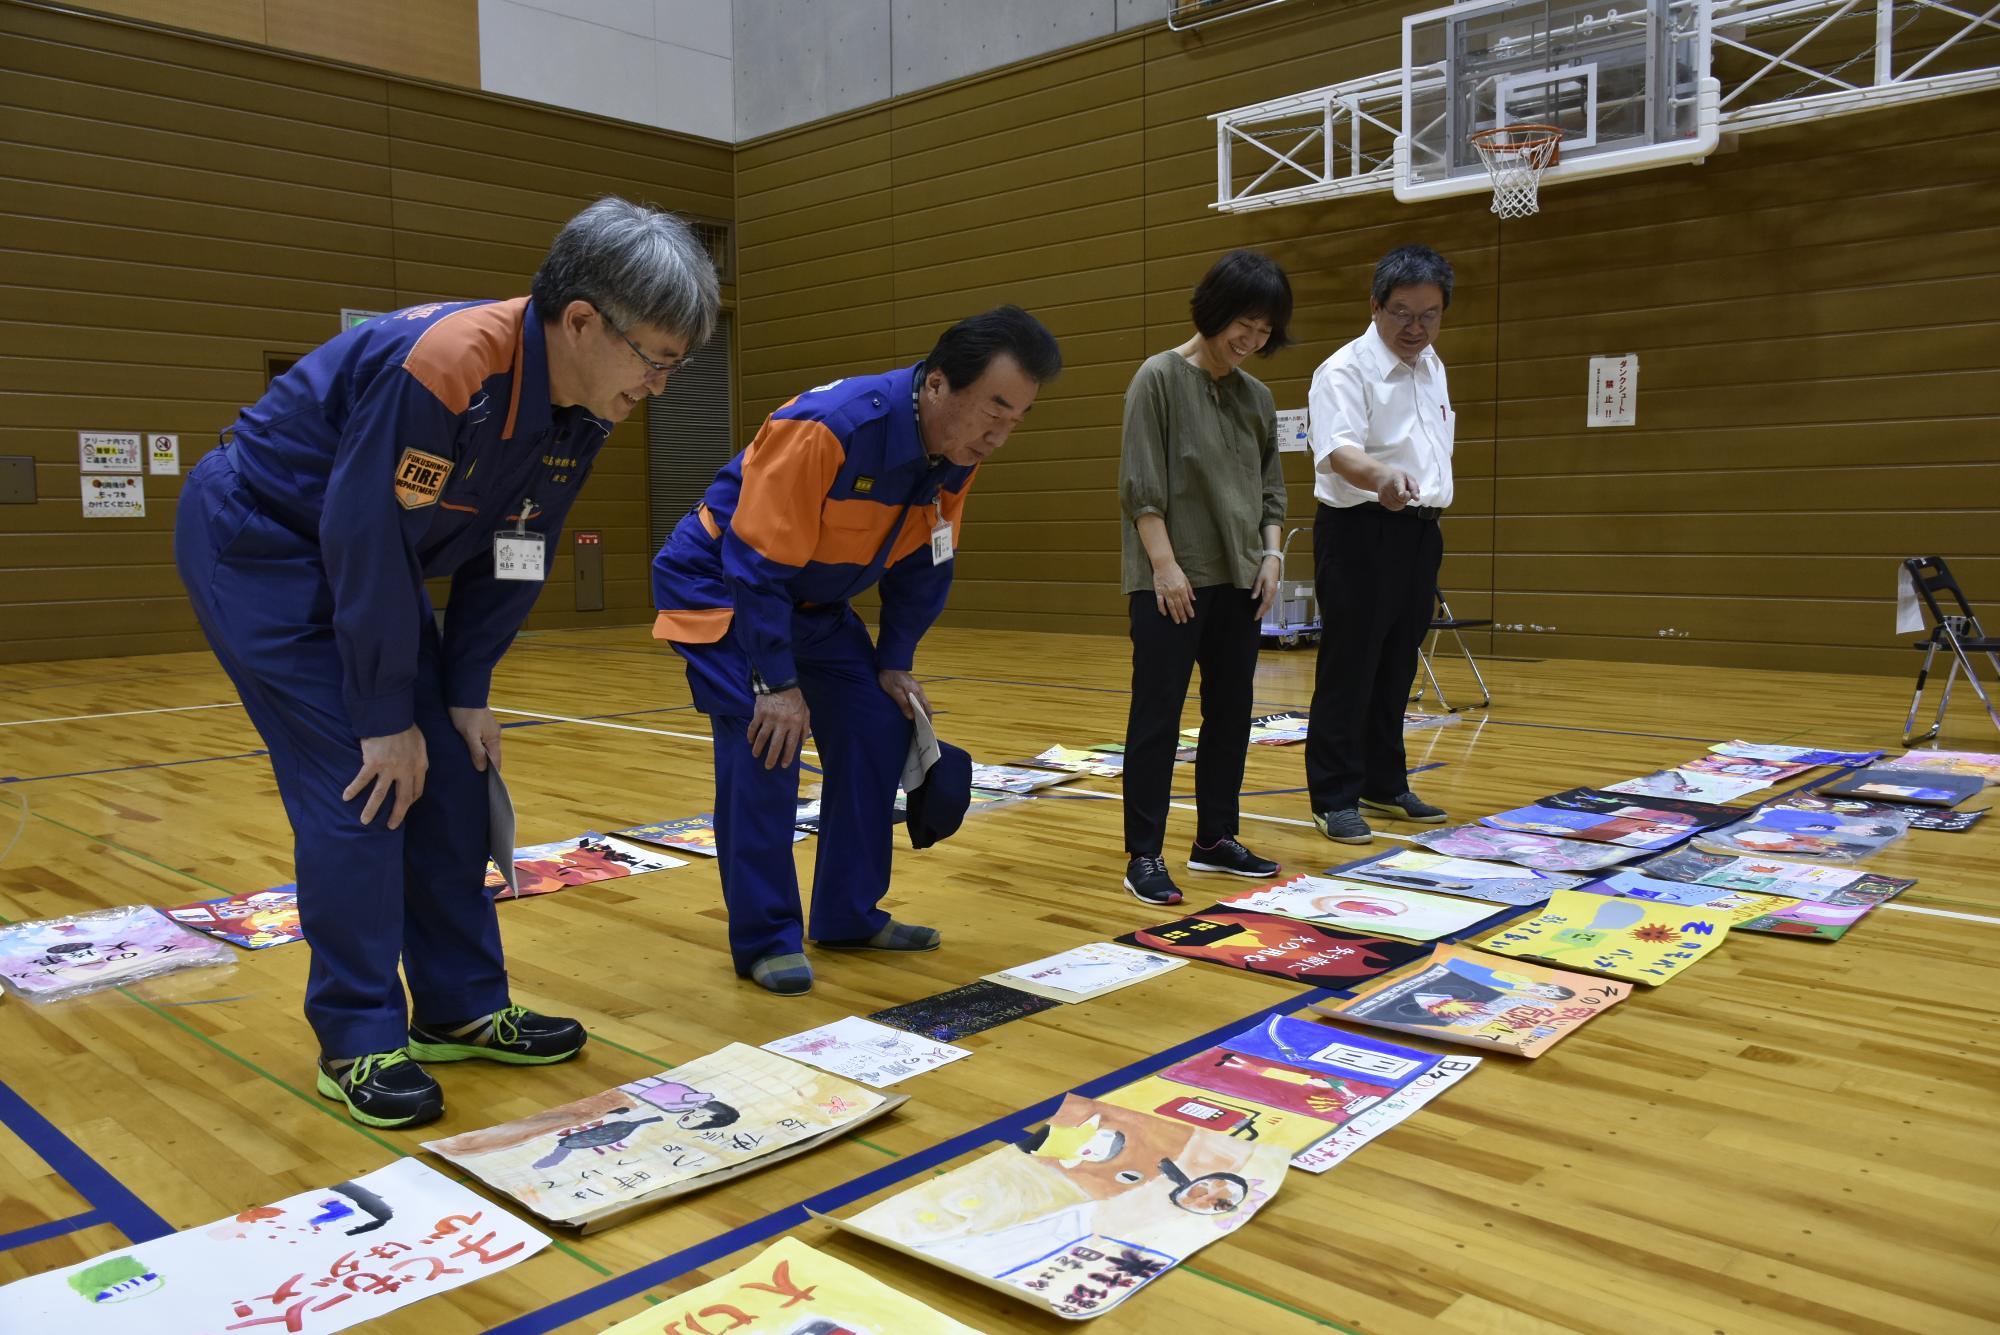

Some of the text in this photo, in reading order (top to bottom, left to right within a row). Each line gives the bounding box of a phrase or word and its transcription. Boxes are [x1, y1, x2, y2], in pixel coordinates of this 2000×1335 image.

[1619, 360, 1627, 414] ダンクシュート
[402, 463, 442, 488] FIRE
[407, 453, 448, 473] FUKUSHIMA
[396, 478, 438, 497] DEPARTMENT
[1243, 935, 1317, 964] 火の用心
